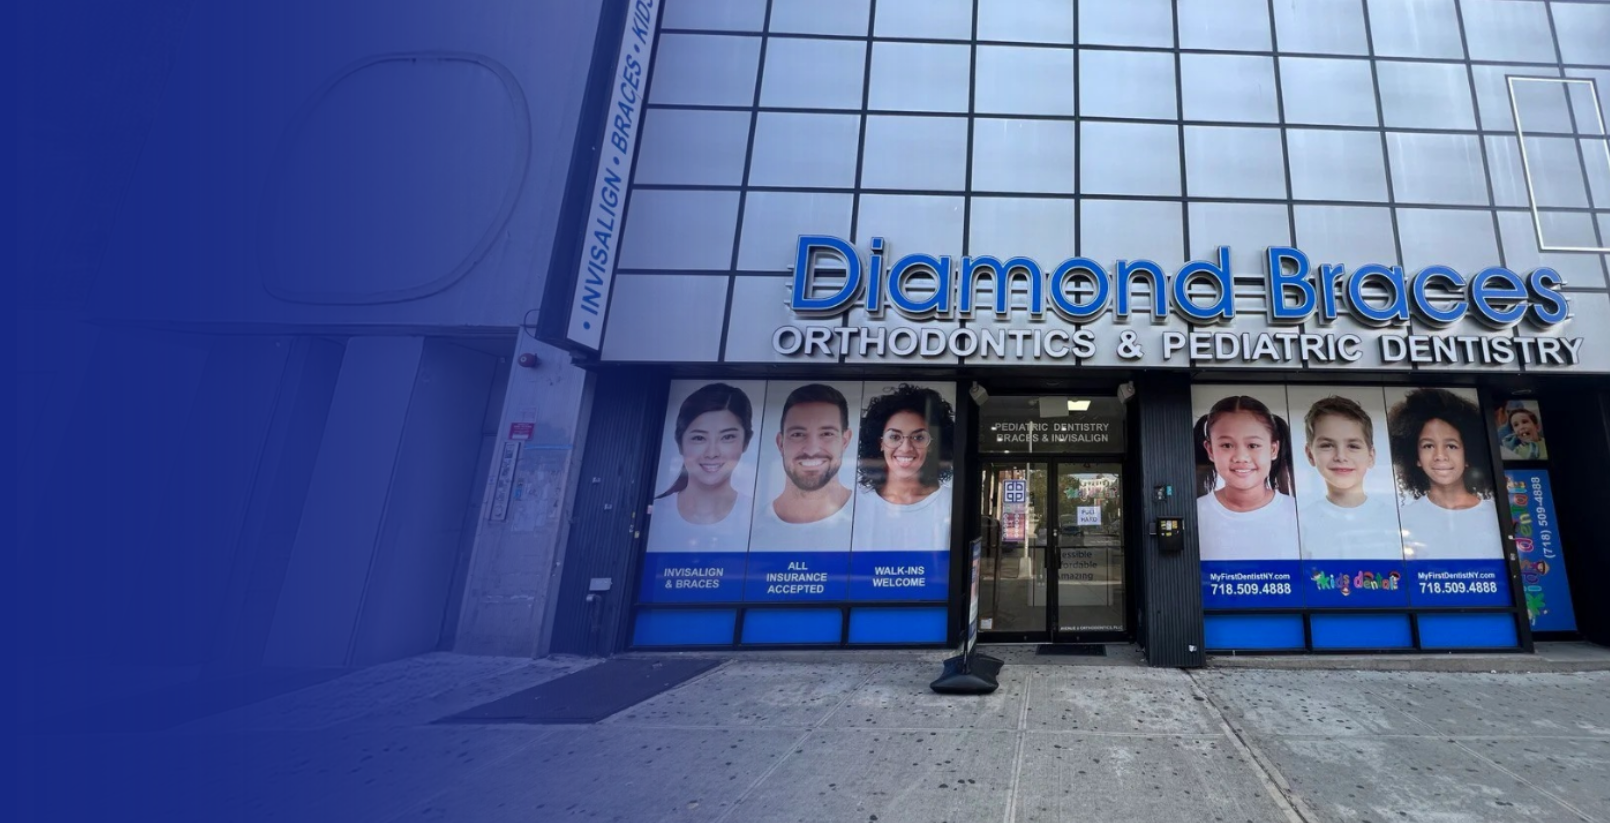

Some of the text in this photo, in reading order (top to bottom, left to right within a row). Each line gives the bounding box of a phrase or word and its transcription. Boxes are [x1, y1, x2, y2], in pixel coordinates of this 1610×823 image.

[580, 167, 622, 316] INVISALIGN
[611, 54, 642, 155] BRACES
[789, 234, 1571, 324] Diamond Braces
[771, 325, 1584, 365] ORTHODONTICS & PEDIATRIC DENTISTRY
[994, 422, 1110, 432] PEDIATRIC DENTISTRY
[996, 433, 1110, 443] BRACES & INVISALIGN
[1531, 476, 1557, 559] (718) 509-4888
[1061, 550, 1093, 559] essible
[787, 561, 808, 571] ALL
[1061, 560, 1098, 569] ordable
[664, 567, 724, 578] INVISALIGN
[874, 565, 925, 576] WALK-INS
[1417, 571, 1496, 580] MyFirstDentistNY.com
[766, 572, 828, 583] INSURANCE
[872, 577, 926, 588] WELCOME
[1210, 572, 1291, 582] MyFirstDentistNY.com
[664, 578, 720, 589] & BRACES
[766, 583, 824, 594] ACCEPTED
[1211, 583, 1292, 595] 718.509.4888
[1419, 582, 1498, 594] 718.509.4888
